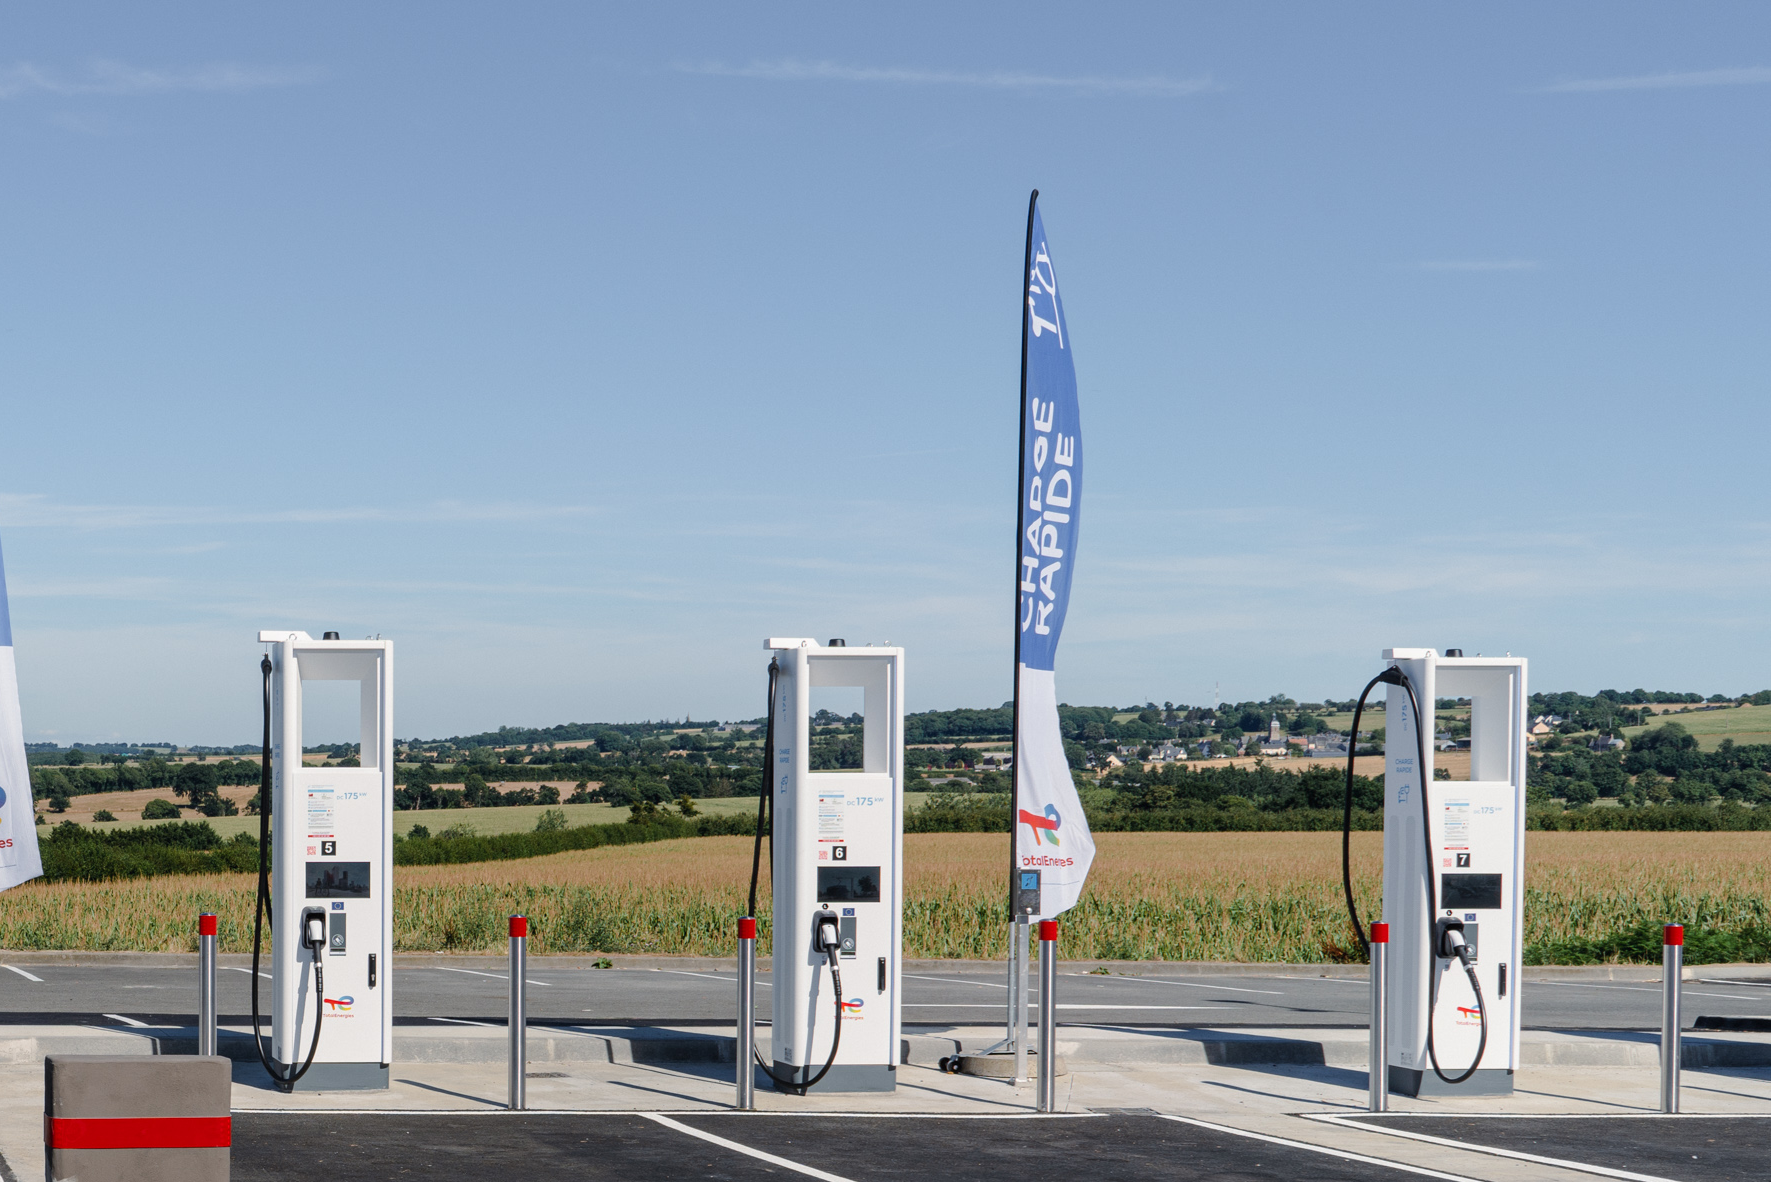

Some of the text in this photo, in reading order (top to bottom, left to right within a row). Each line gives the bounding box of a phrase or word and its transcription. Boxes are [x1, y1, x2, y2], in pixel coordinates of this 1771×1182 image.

[1034, 432, 1075, 636] RAPIDE
[344, 792, 359, 800] 175
[856, 797, 874, 806] 175
[1480, 806, 1495, 814] 175
[324, 842, 333, 854] 5
[835, 847, 844, 859] 6
[1459, 854, 1468, 866] 7
